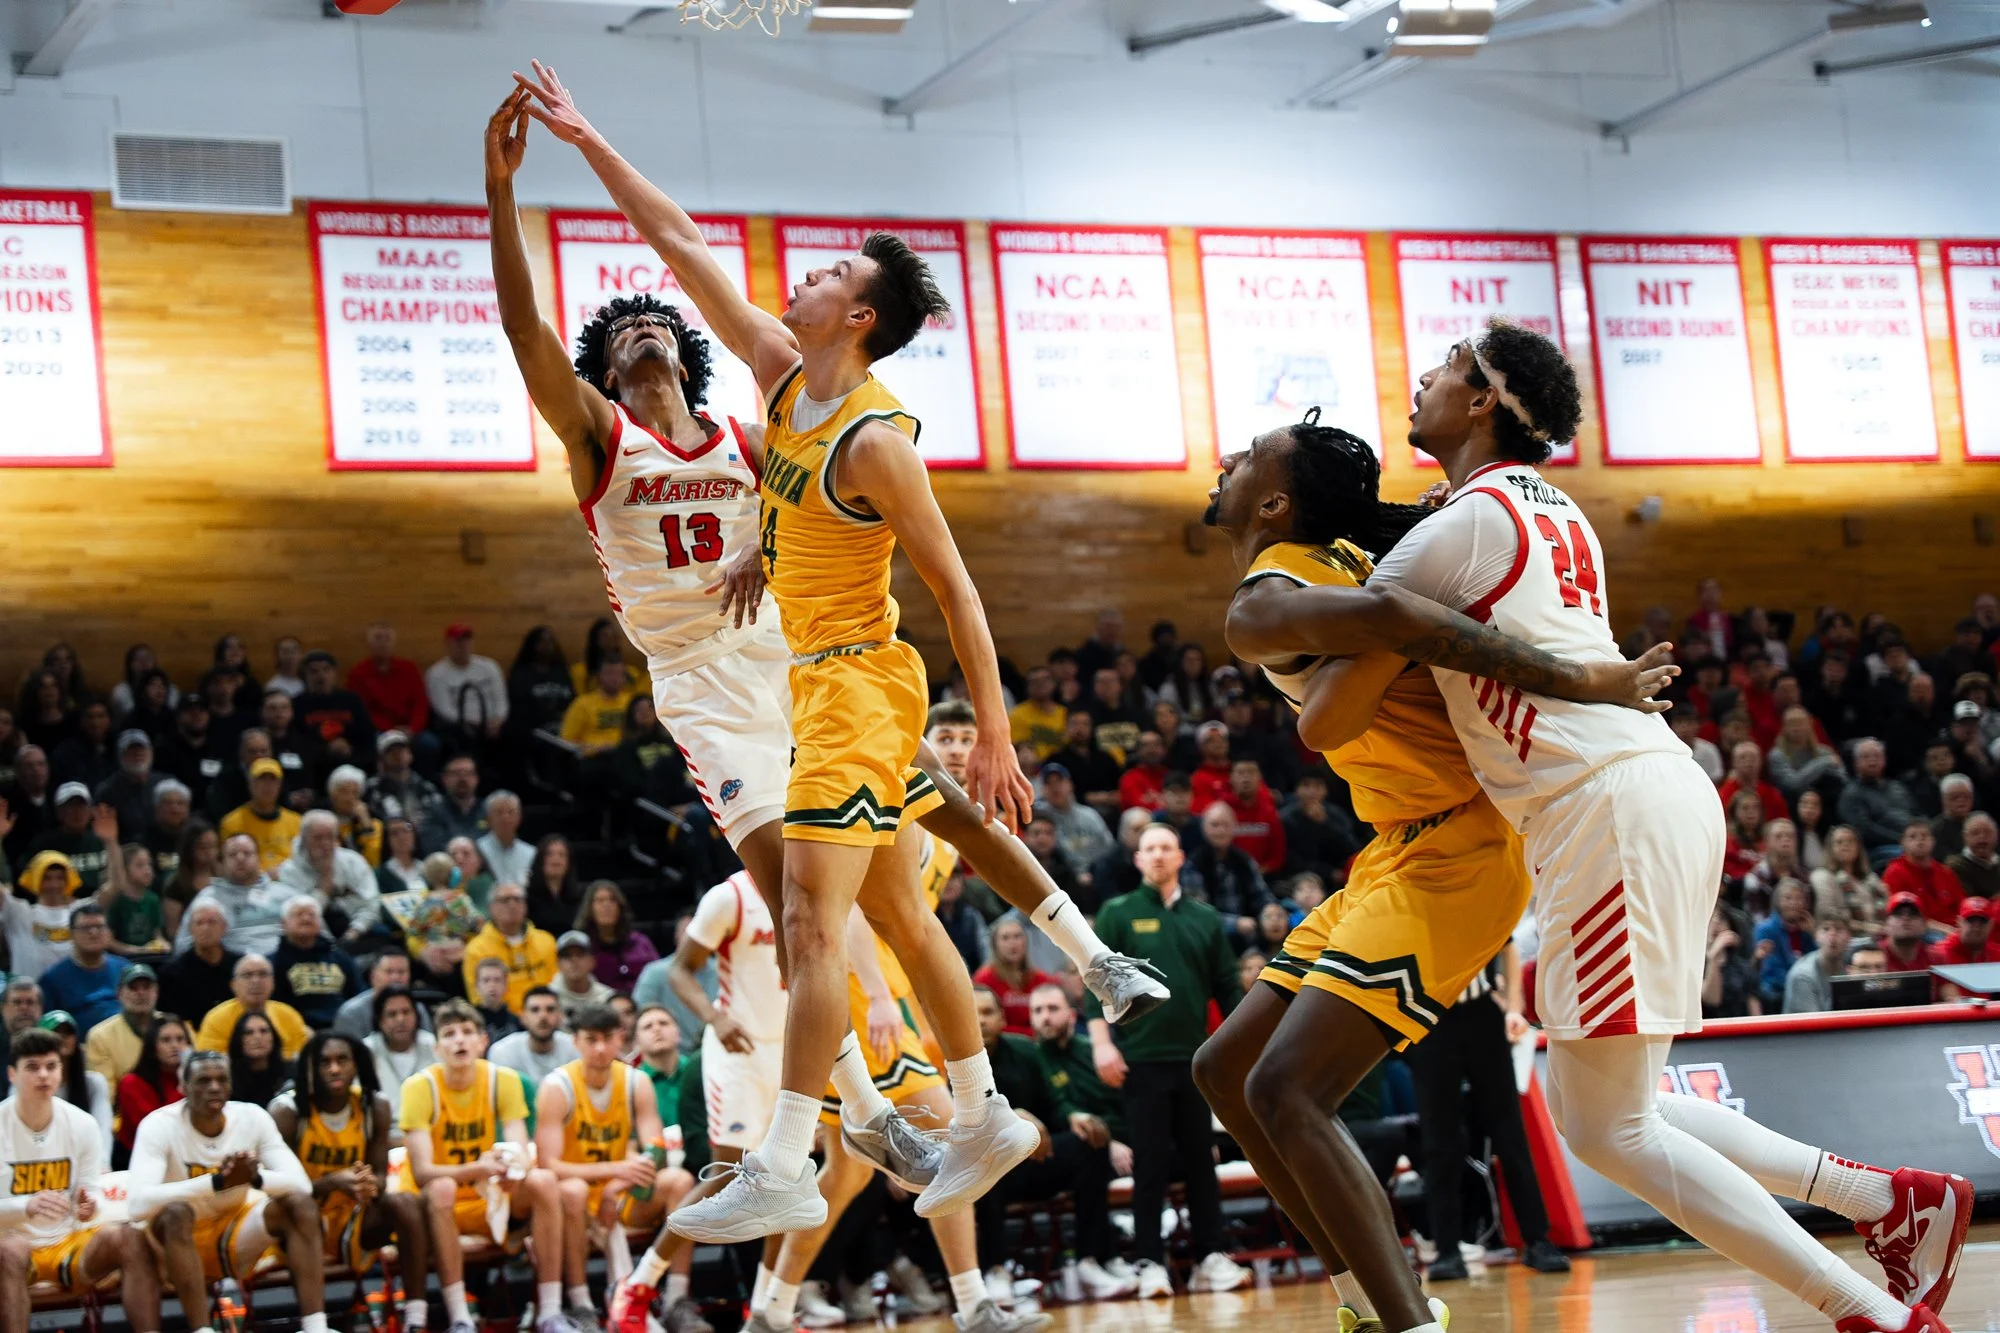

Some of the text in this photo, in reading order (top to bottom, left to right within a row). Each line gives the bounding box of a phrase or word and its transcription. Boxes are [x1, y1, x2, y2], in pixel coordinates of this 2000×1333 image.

[378, 248, 461, 269] MAAC
[342, 274, 423, 291] REGULAR
[599, 263, 681, 292] NCA
[1035, 272, 1137, 300] NCAA
[1238, 275, 1337, 300] NCAA
[1450, 278, 1509, 304] NIT
[1637, 280, 1694, 306] NIT
[342, 297, 502, 324] CHAMPIONS
[1604, 317, 1737, 338] SECOND ROUND
[356, 336, 412, 352] 2004
[659, 512, 724, 570] 13
[1534, 513, 1603, 618] 24
